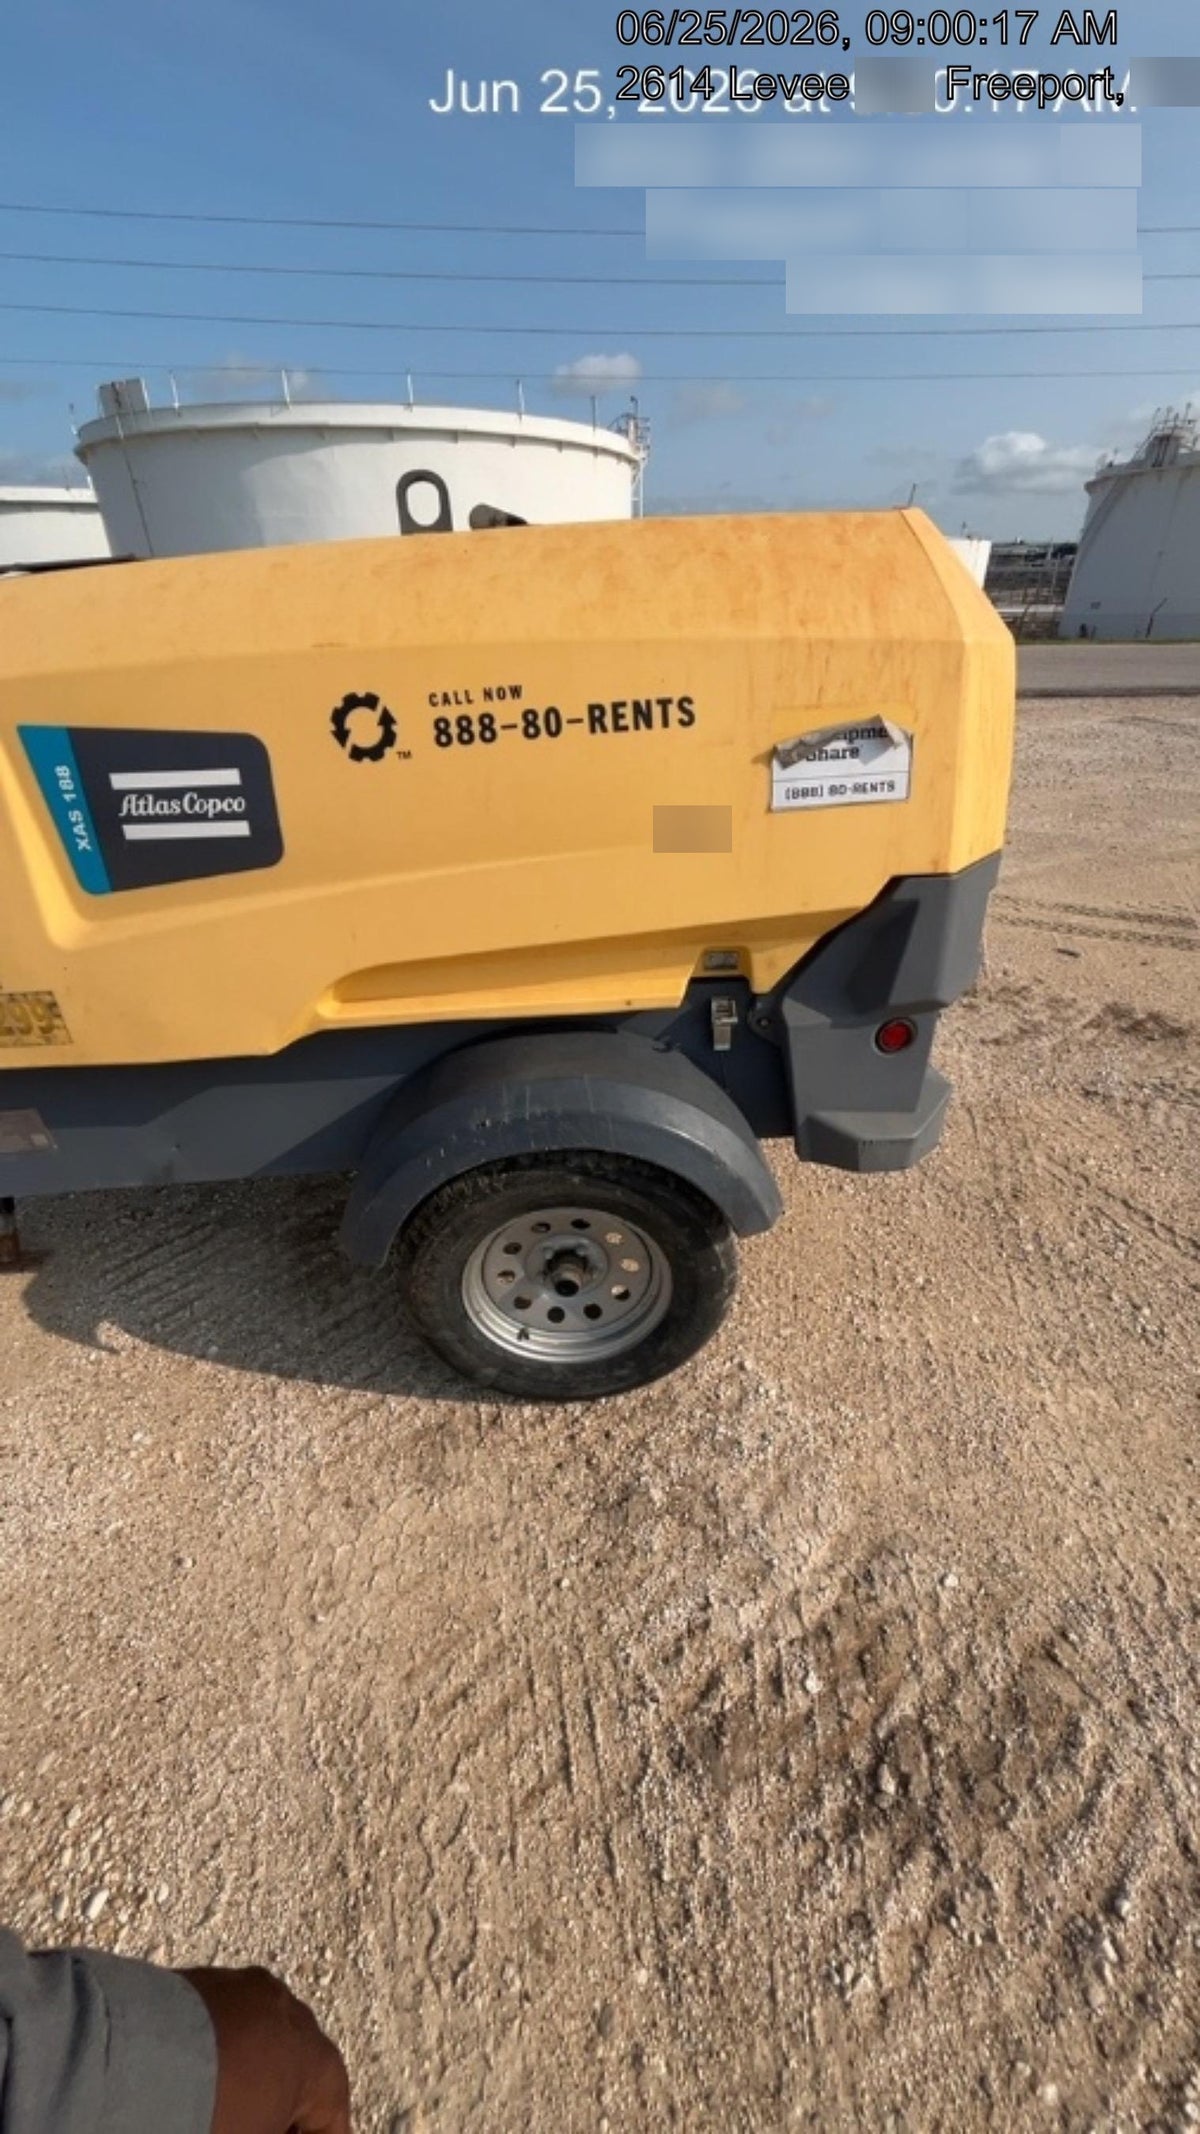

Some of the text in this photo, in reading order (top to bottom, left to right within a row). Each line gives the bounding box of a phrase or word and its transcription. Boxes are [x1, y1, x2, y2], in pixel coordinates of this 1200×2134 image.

[428, 685, 524, 707] CALL NOW
[433, 695, 697, 748] 888-80-RENTS
[54, 765, 92, 852] XAS 188
